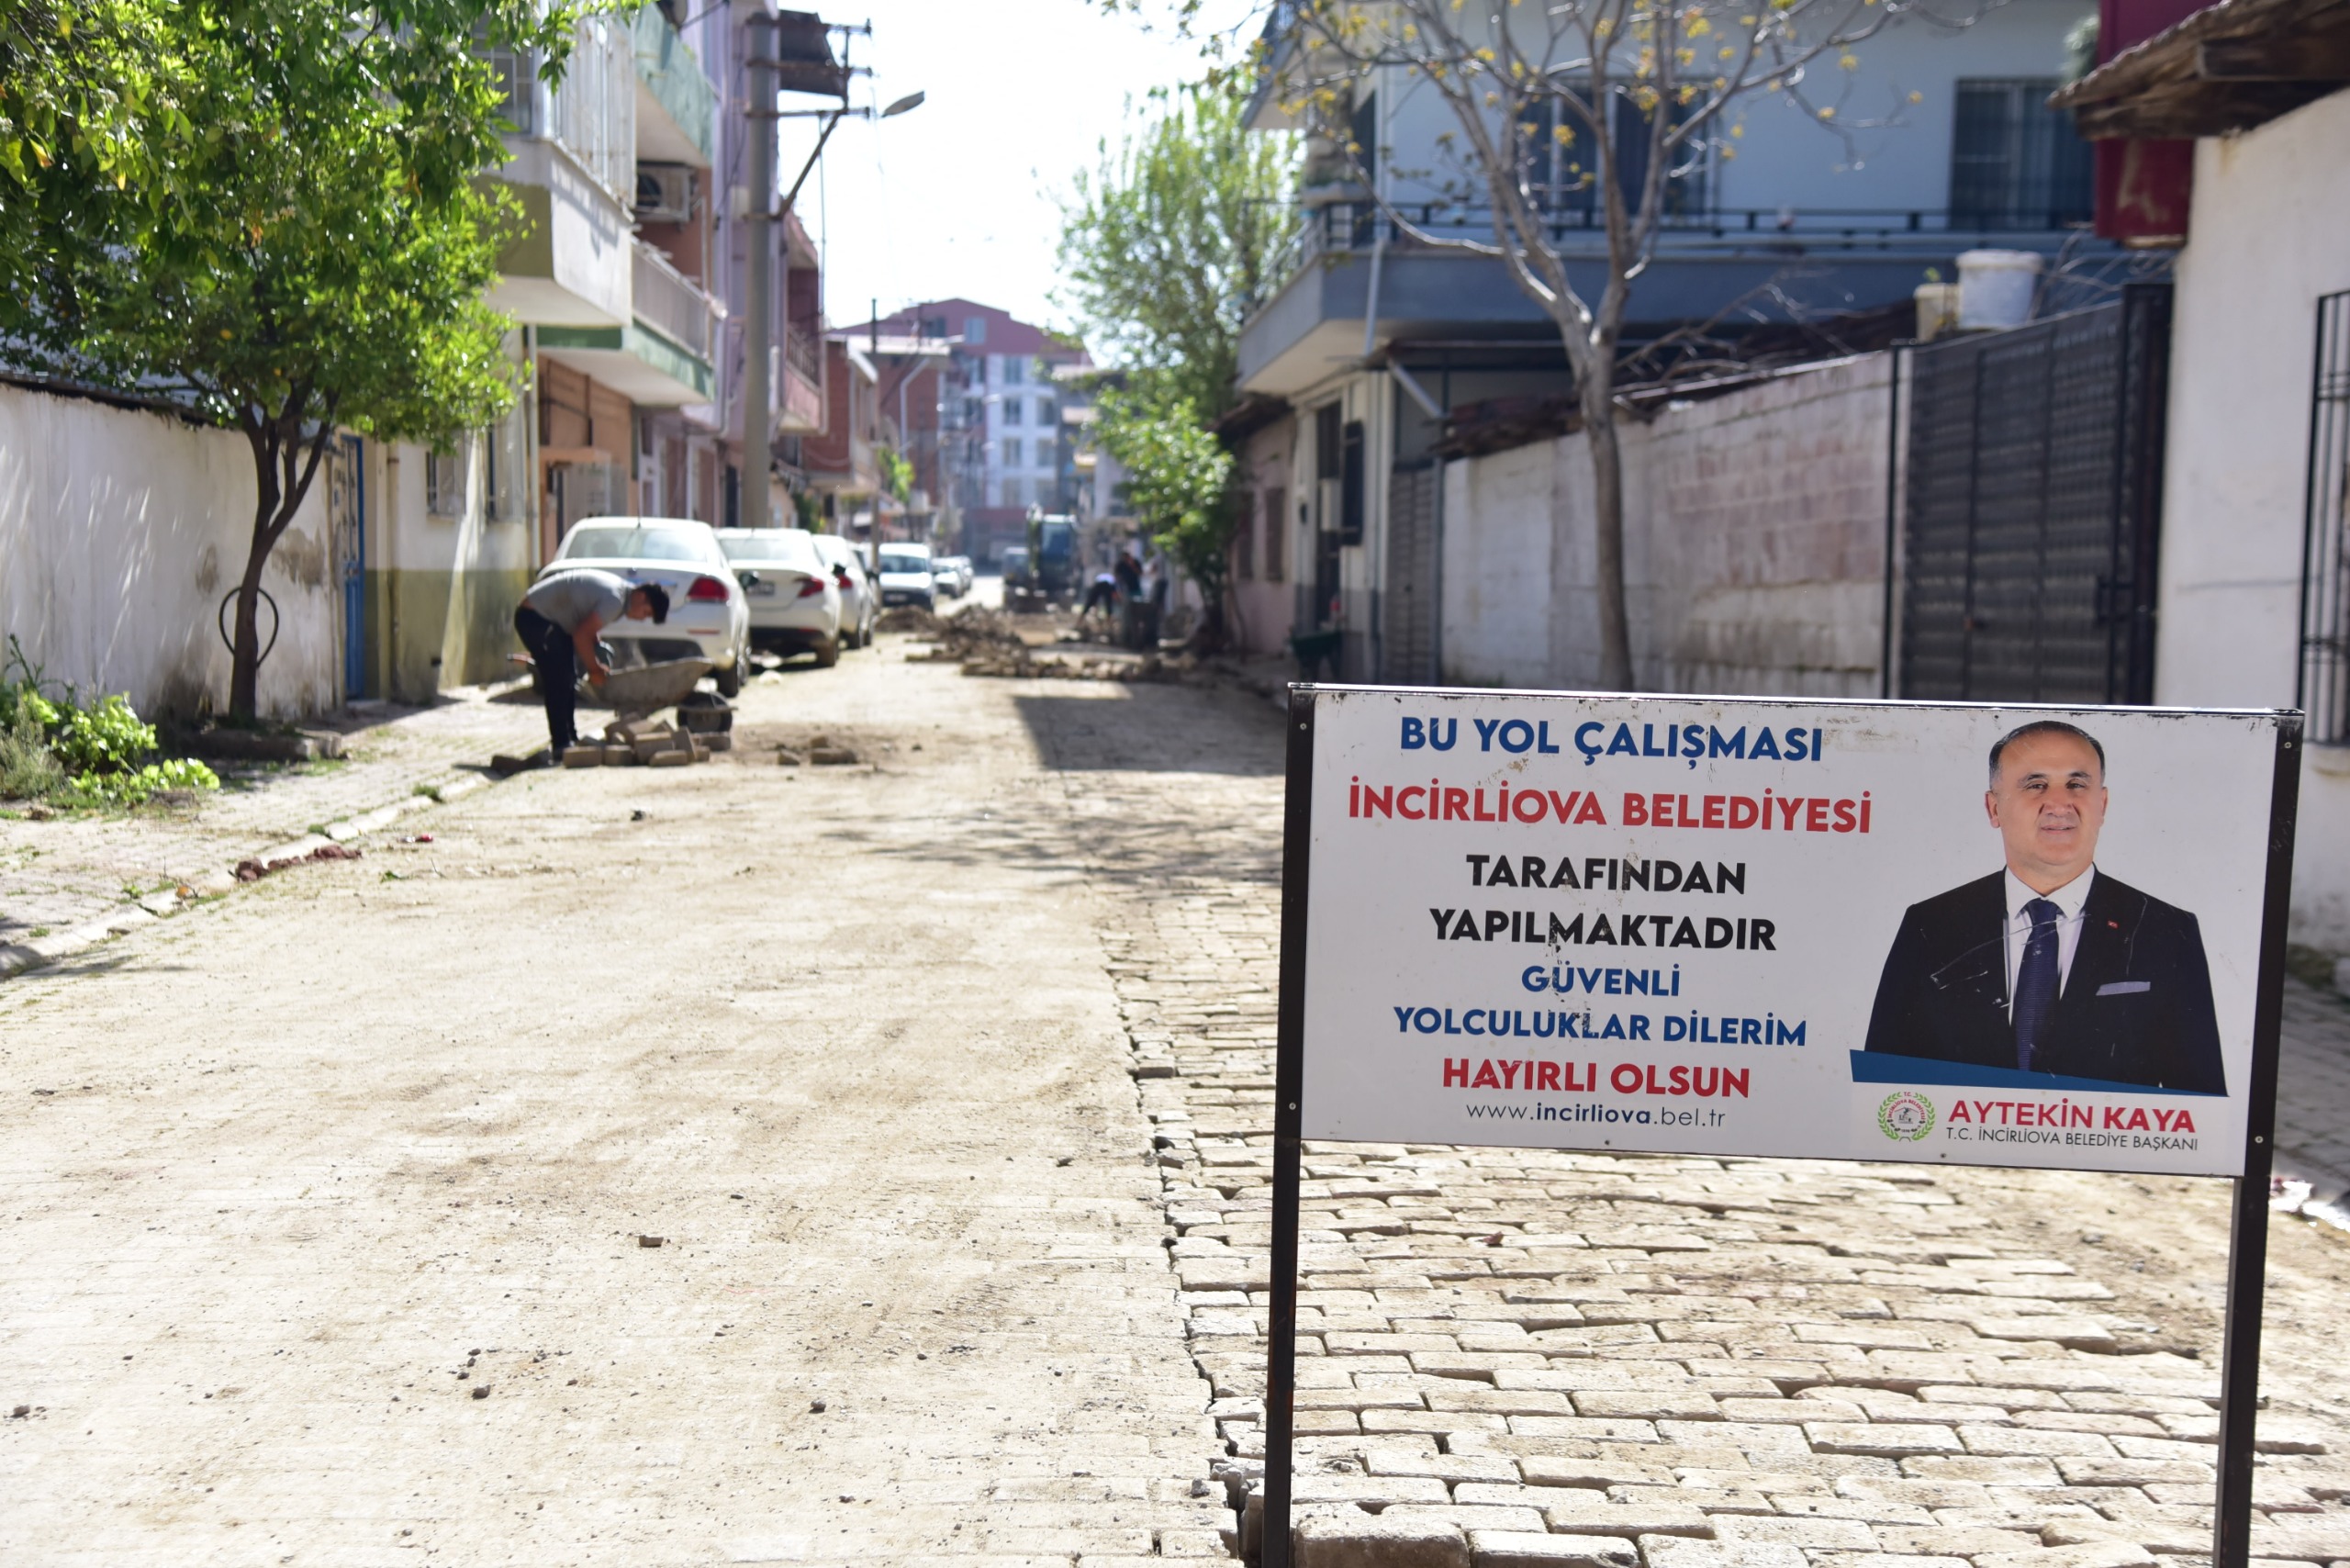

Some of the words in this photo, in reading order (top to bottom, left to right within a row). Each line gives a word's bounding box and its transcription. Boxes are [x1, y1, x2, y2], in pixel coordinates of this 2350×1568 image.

[1401, 717, 1457, 751] BU
[1473, 719, 1560, 754] YOL
[1574, 722, 1822, 770] ÇALIŞMASI
[1349, 776, 1606, 824] İNCİRLİOVA
[1623, 787, 1872, 834] BELEDİYESİ
[1466, 855, 1746, 894] TARAFINDAN
[1429, 909, 1777, 951] YAPILMAKTADIR
[1522, 961, 1680, 997] GÜVENLİ
[1393, 1007, 1651, 1041] YOLCULUKLAR
[1663, 1010, 1807, 1047] DİLERİM
[1443, 1058, 1596, 1092] HAYIRLI
[1611, 1063, 1750, 1098] OLSUN
[1467, 1102, 1726, 1127] www.incirliova.bel.tr
[1949, 1098, 2093, 1128] AYTEKİN
[2103, 1106, 2196, 1134] KAYA
[1946, 1127, 1973, 1140] T.C.
[1978, 1126, 2061, 1144] İNCİRLİOVA
[2065, 1132, 2128, 1148] BELEDİYE
[2133, 1136, 2199, 1152] BAŞKANI
